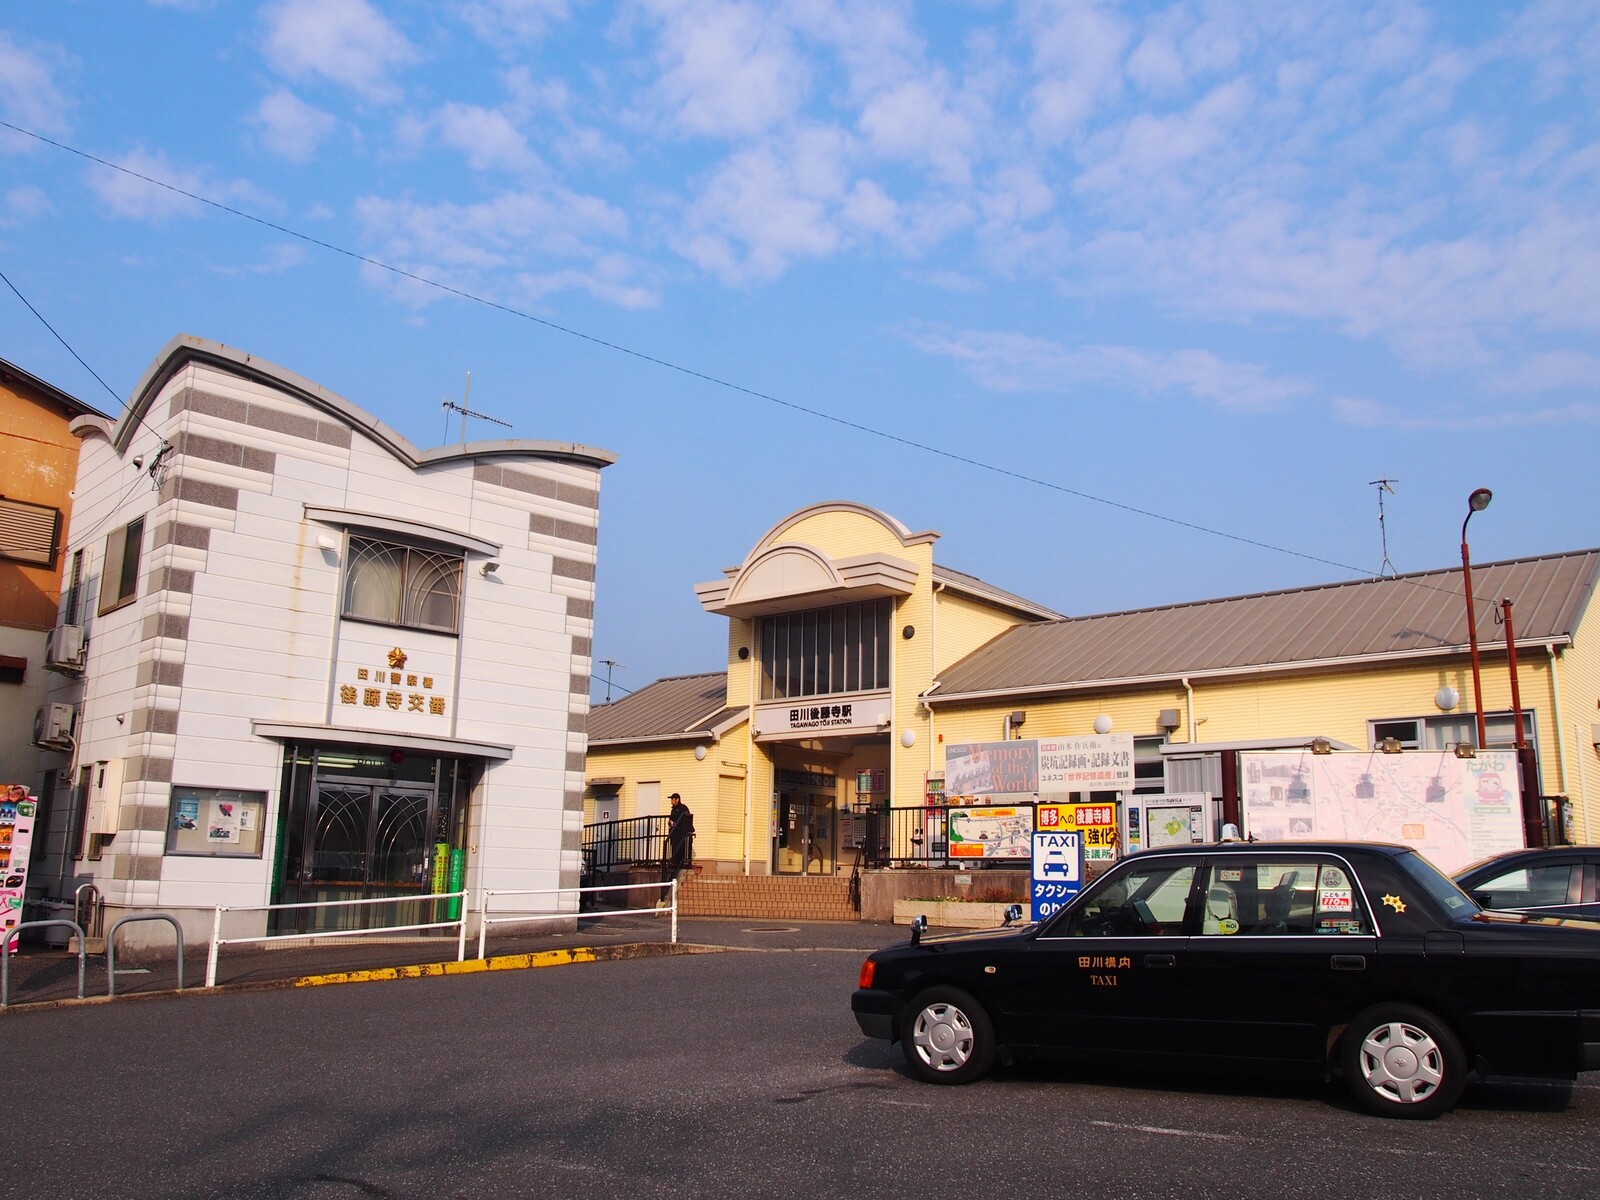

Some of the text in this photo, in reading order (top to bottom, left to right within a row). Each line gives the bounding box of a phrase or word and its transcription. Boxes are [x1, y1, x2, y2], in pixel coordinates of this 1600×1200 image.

[357, 668, 434, 689] 田川警察署
[339, 683, 445, 716] 後藤寺交番
[790, 704, 852, 721] 田川後藤寺駅
[947, 746, 967, 754] UNESCO
[969, 744, 1033, 763] Memory
[992, 758, 1028, 775] of the
[991, 772, 1038, 792] World
[1037, 836, 1075, 847] TAXI
[1034, 883, 1078, 898] タクシー
[1039, 902, 1065, 916] のり
[1078, 956, 1131, 969] 田川構内
[1089, 975, 1118, 986] TAXI
